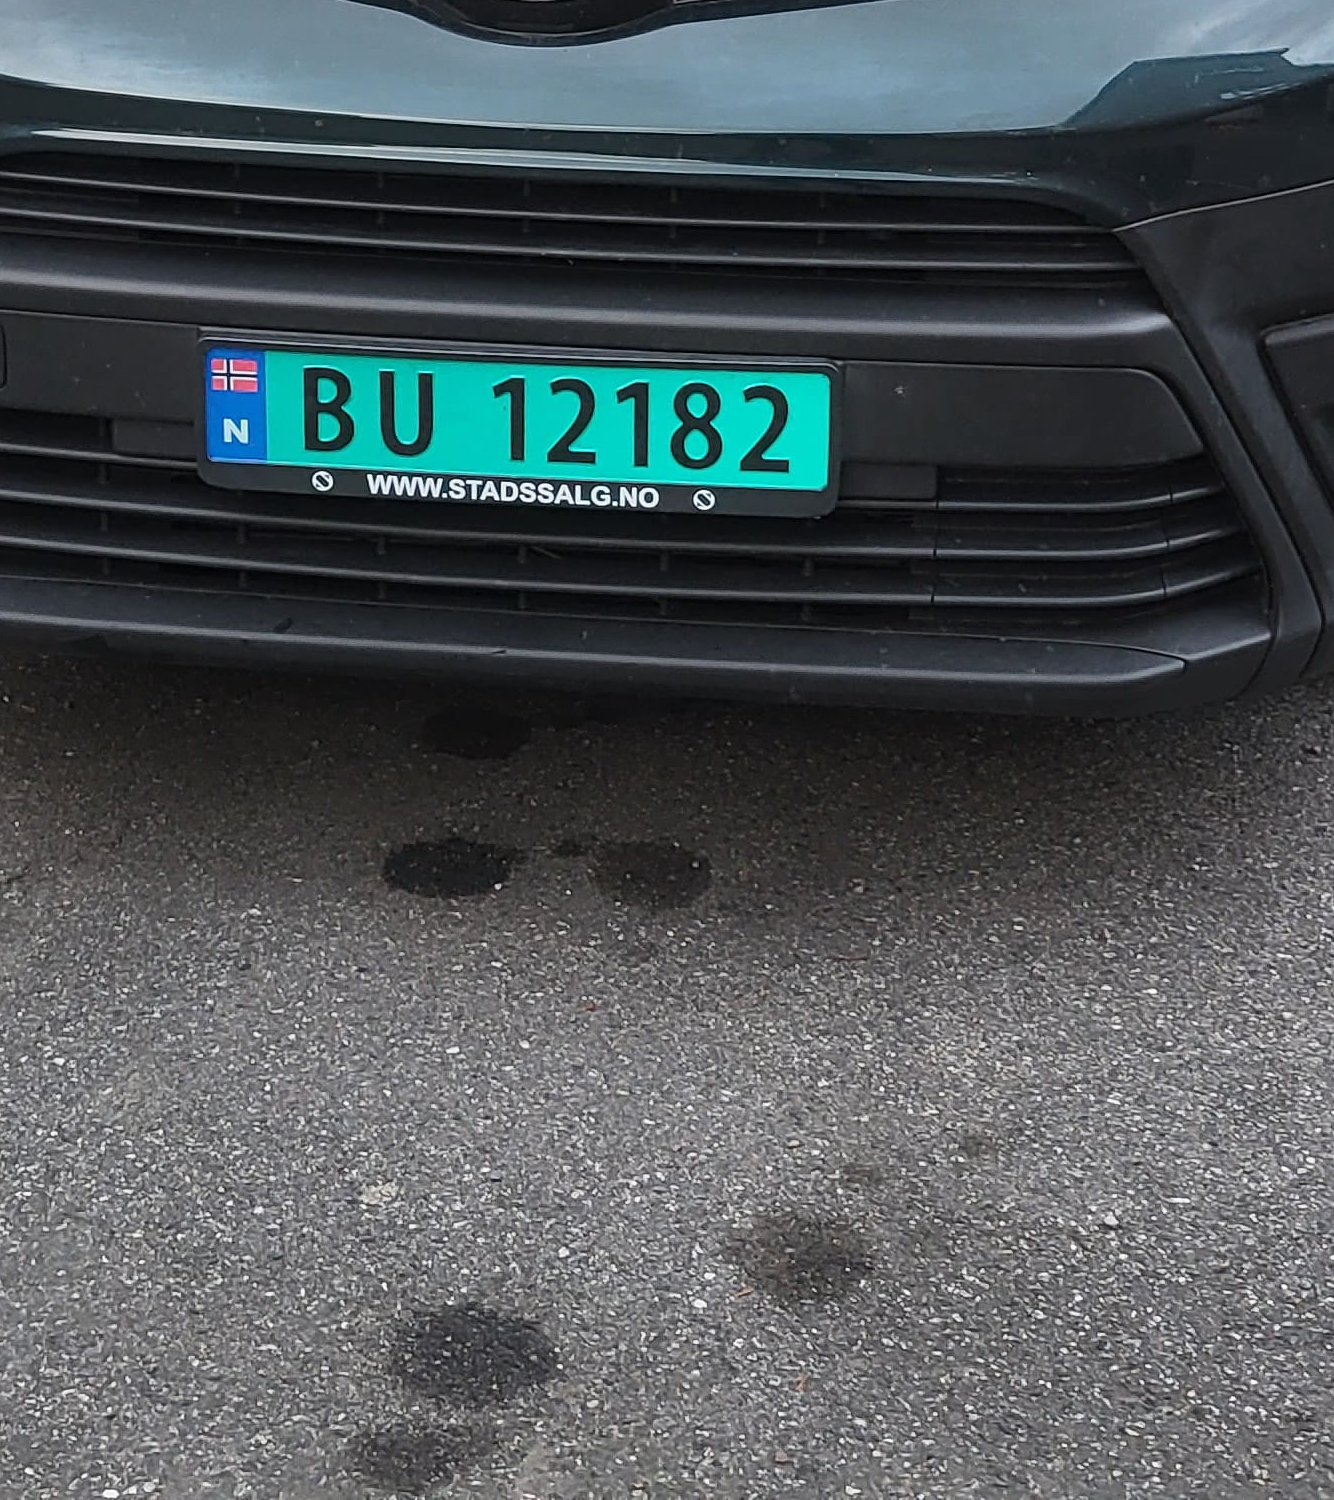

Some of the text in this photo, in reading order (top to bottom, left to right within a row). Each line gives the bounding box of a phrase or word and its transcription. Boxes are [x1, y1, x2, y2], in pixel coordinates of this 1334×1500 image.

[224, 418, 250, 444] N
[302, 366, 791, 474] BU 12182
[366, 473, 660, 508] WWW.STADSSALG.NO
